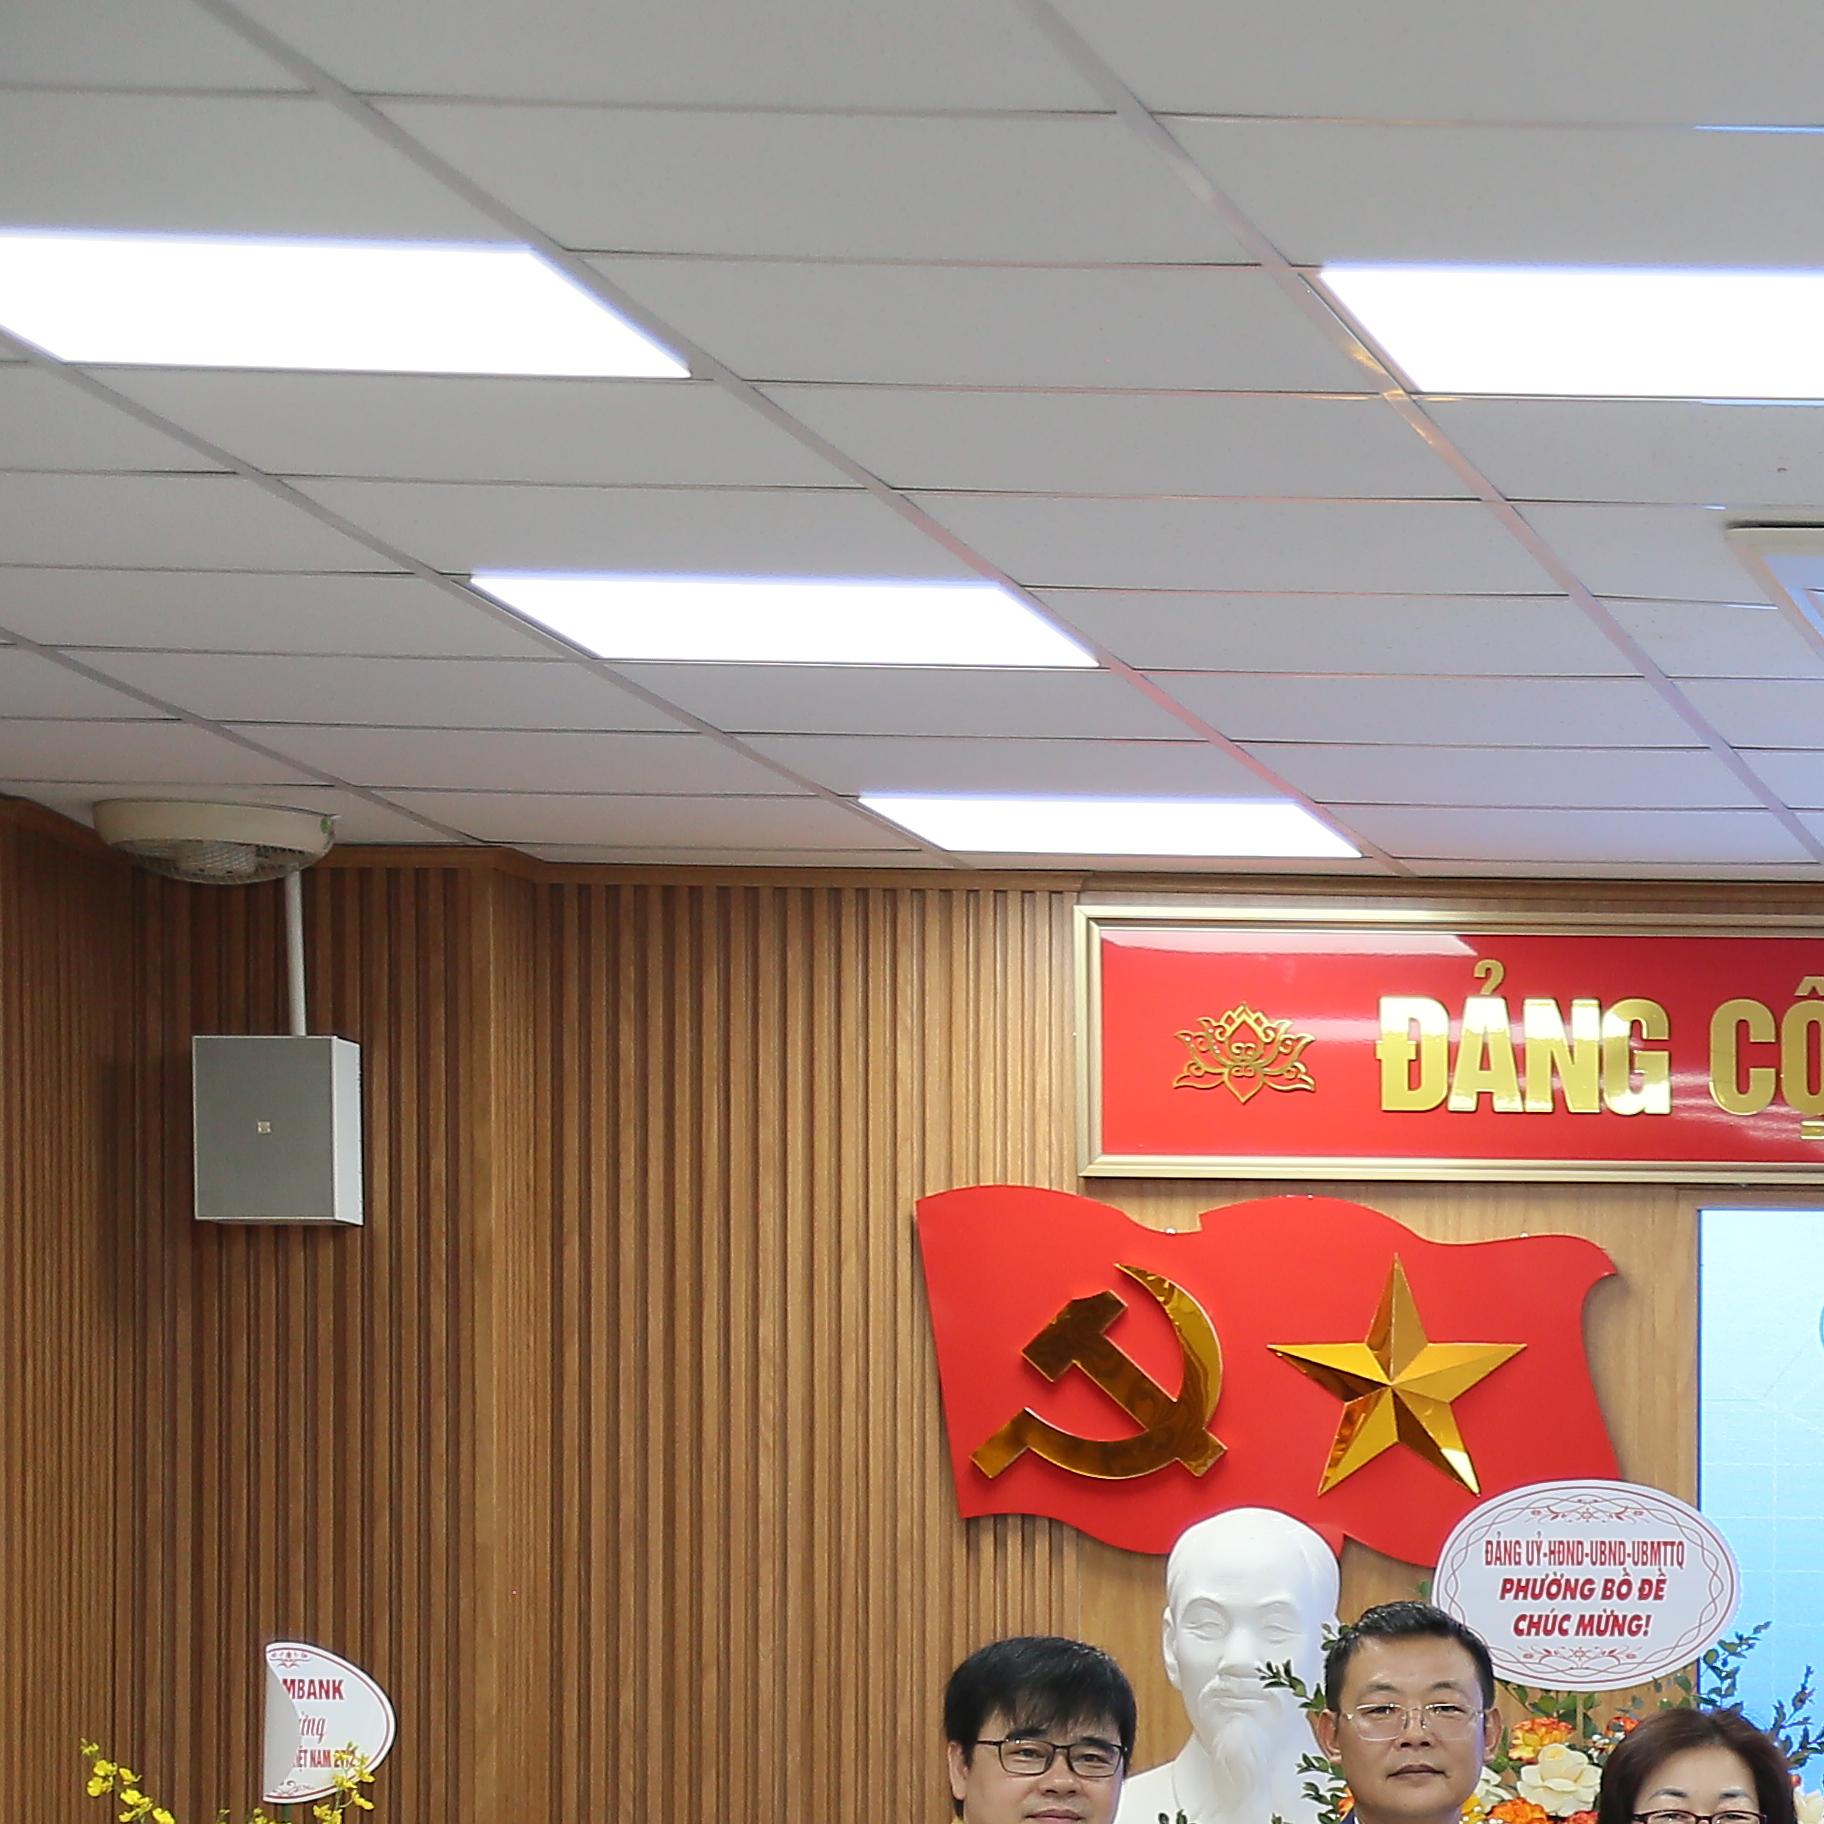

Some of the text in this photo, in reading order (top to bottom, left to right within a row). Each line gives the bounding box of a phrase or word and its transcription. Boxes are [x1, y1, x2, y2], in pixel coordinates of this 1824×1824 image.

[1376, 960, 1672, 1117] ĐẢNG
[1484, 1531, 1522, 1567] ĐẢNG
[1499, 1571, 1597, 1601] PHƯỜNG
[1513, 1608, 1652, 1637] CHÚC MỪNG!
[282, 1678, 345, 1701] MBANK
[309, 1749, 332, 1768] NAM
